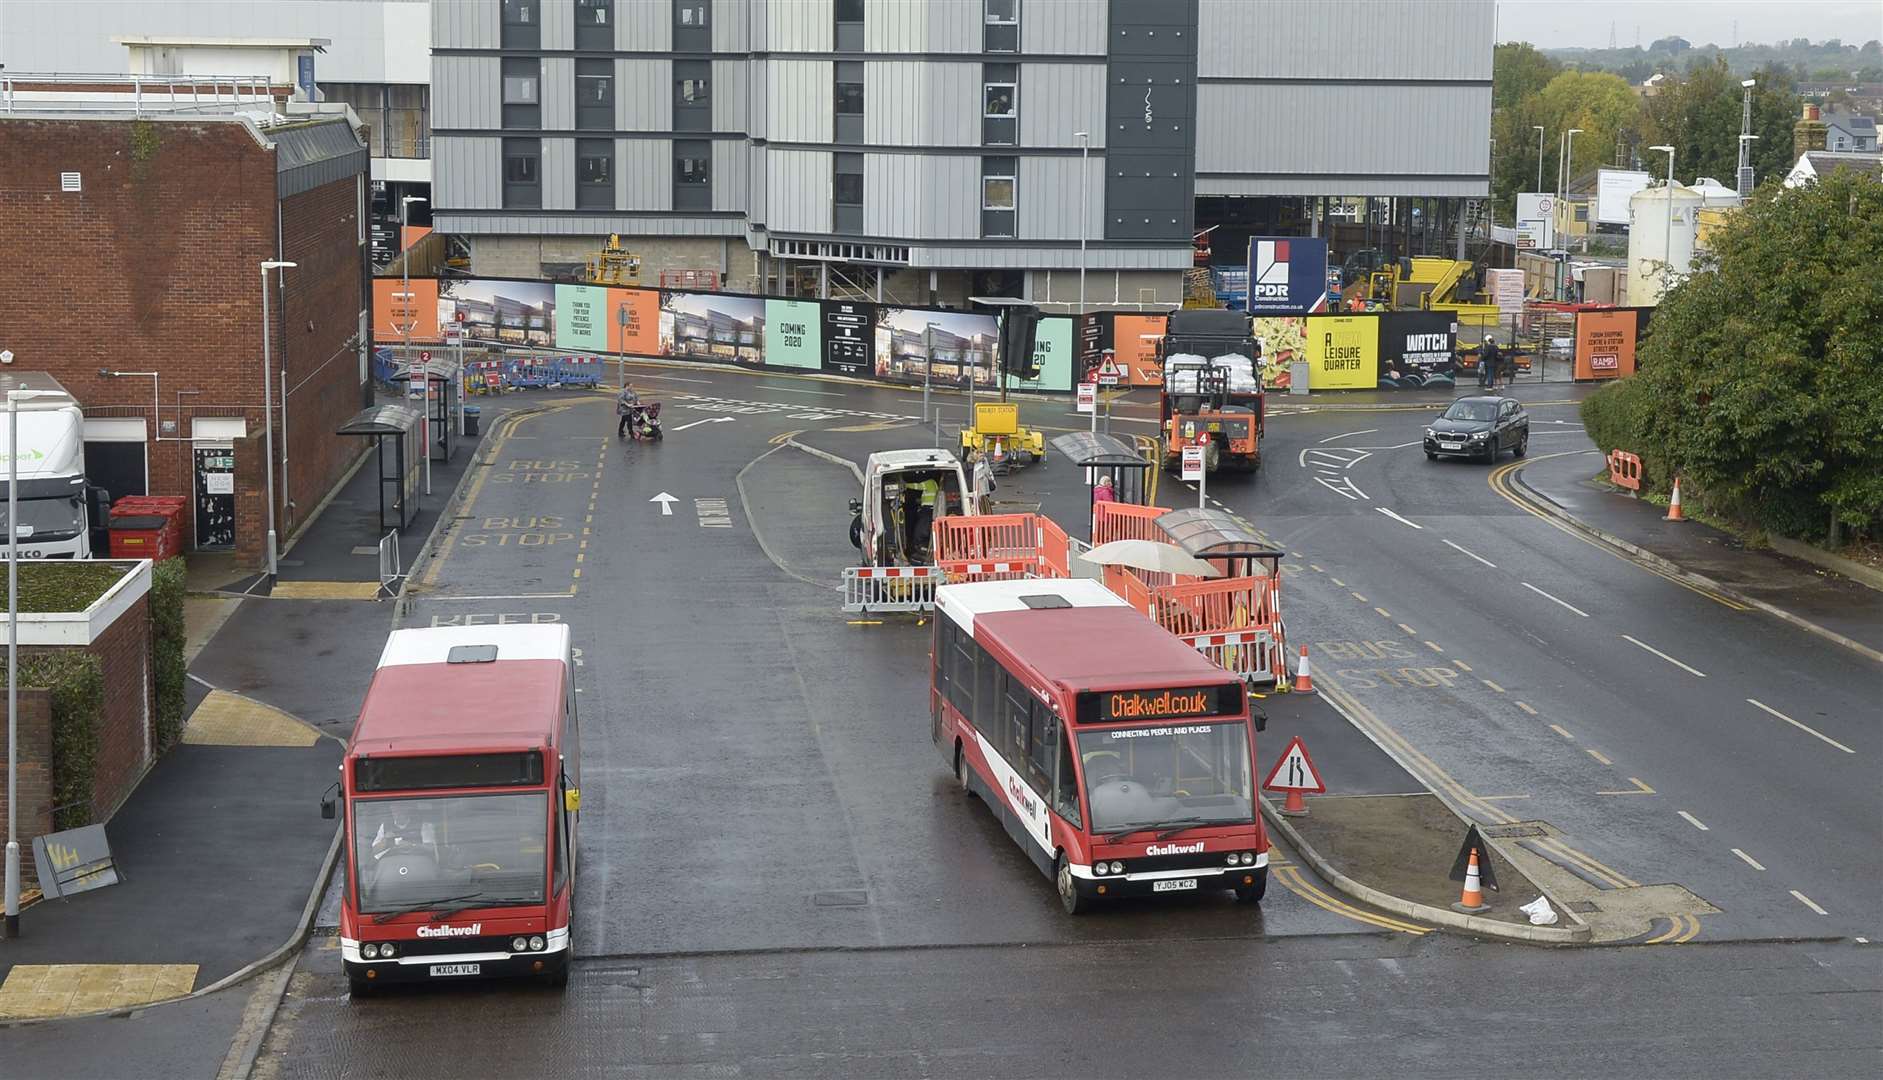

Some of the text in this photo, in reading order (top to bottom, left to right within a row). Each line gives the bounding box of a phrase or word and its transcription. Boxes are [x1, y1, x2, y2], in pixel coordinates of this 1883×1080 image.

[1255, 285, 1288, 297] PDR
[780, 323, 806, 335] COMING
[784, 336, 802, 347] 2020
[1325, 332, 1332, 347] A
[1406, 333, 1448, 352] WATCH
[1037, 341, 1051, 352] ING
[1324, 347, 1361, 359] LEISURE
[1034, 354, 1045, 365] 20
[1324, 359, 1361, 371] QUARTER
[509, 460, 581, 470] BUS
[491, 473, 589, 483] STOP
[482, 516, 564, 529] BUS
[461, 533, 575, 546] STOP
[2, 550, 41, 559] IECO
[1315, 640, 1417, 660] BUS
[1337, 667, 1460, 689] STOP
[1111, 691, 1207, 718] Chalkwell.co.uk
[1111, 725, 1211, 739] CONNECTING PEOPLE AND PLACES
[1009, 775, 1037, 821] Chalkwell
[1146, 842, 1204, 856] Chalkwell
[1156, 881, 1177, 890] YJ05
[417, 923, 481, 938] Chalkwell
[436, 964, 478, 976] MX04 VLR
